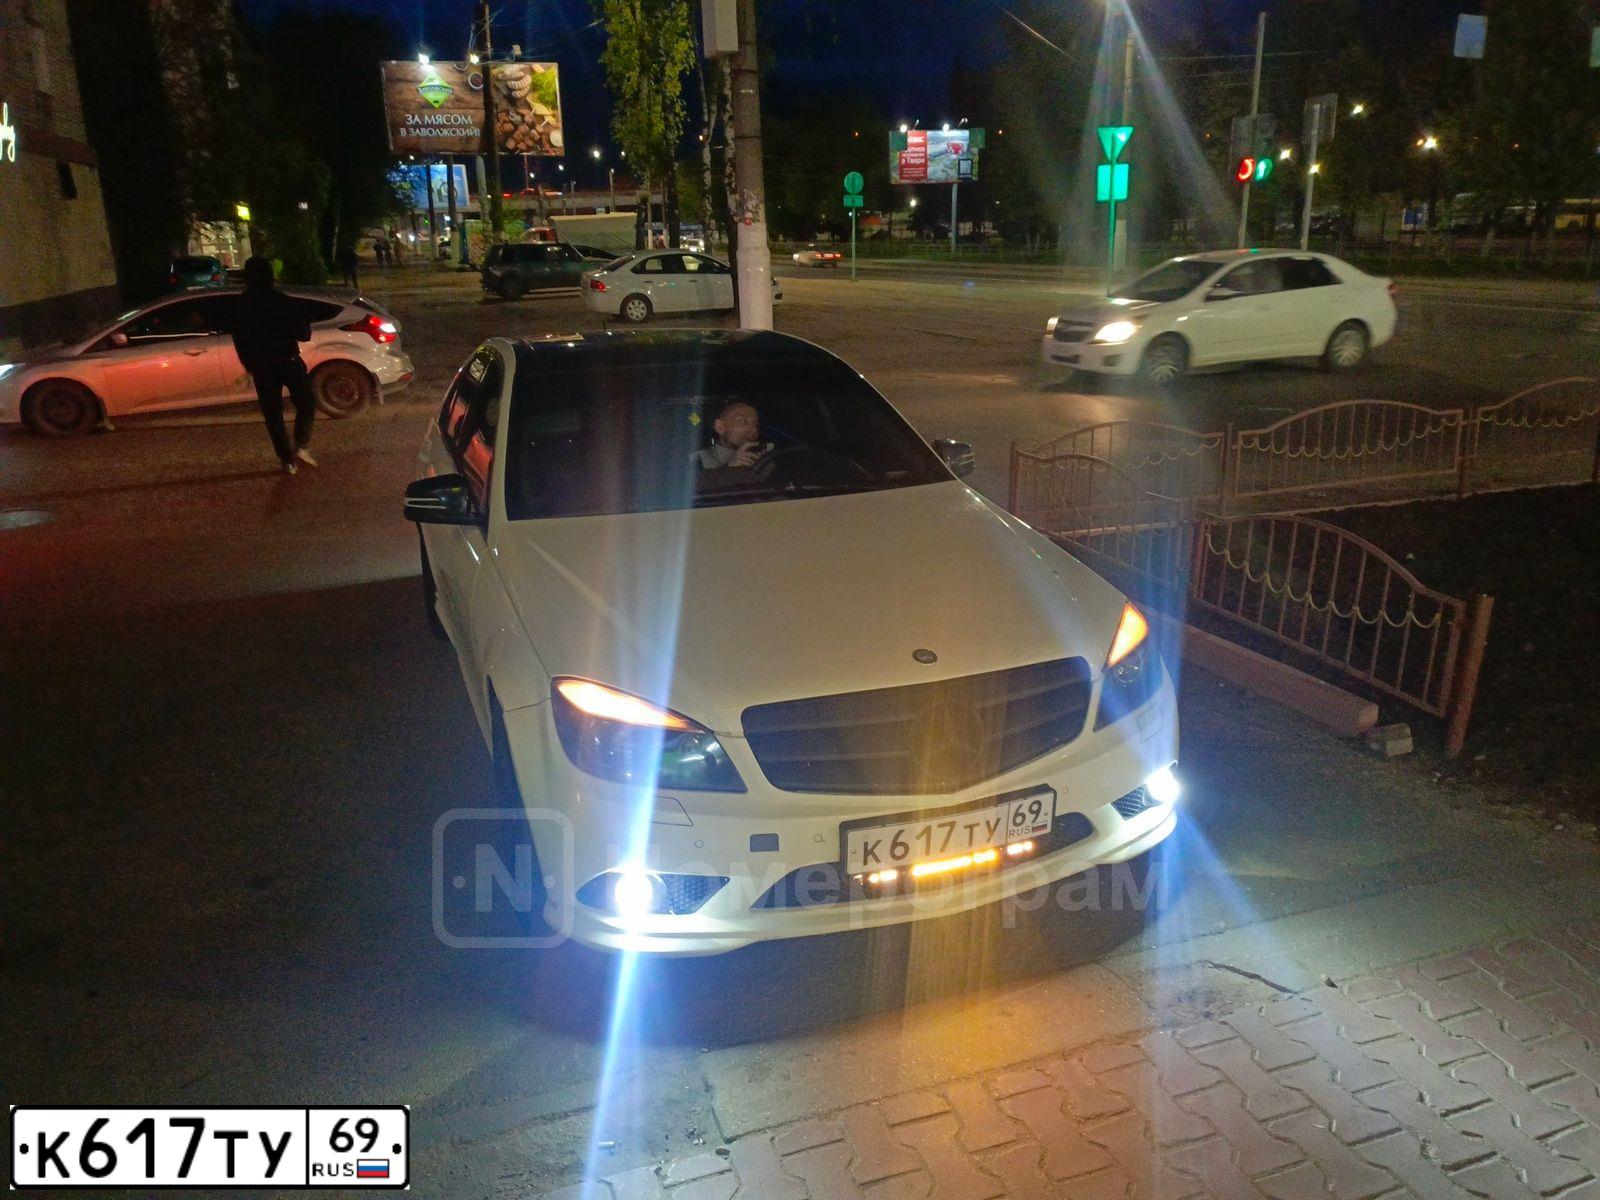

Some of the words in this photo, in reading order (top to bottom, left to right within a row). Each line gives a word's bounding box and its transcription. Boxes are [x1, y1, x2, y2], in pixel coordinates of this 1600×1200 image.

[405, 114, 422, 125] ЗА
[424, 114, 473, 125] МЯСОМ
[400, 127, 408, 137] В
[863, 817, 1002, 866] К617ТУ
[1012, 800, 1043, 828] 69
[1008, 826, 1031, 838] RUS
